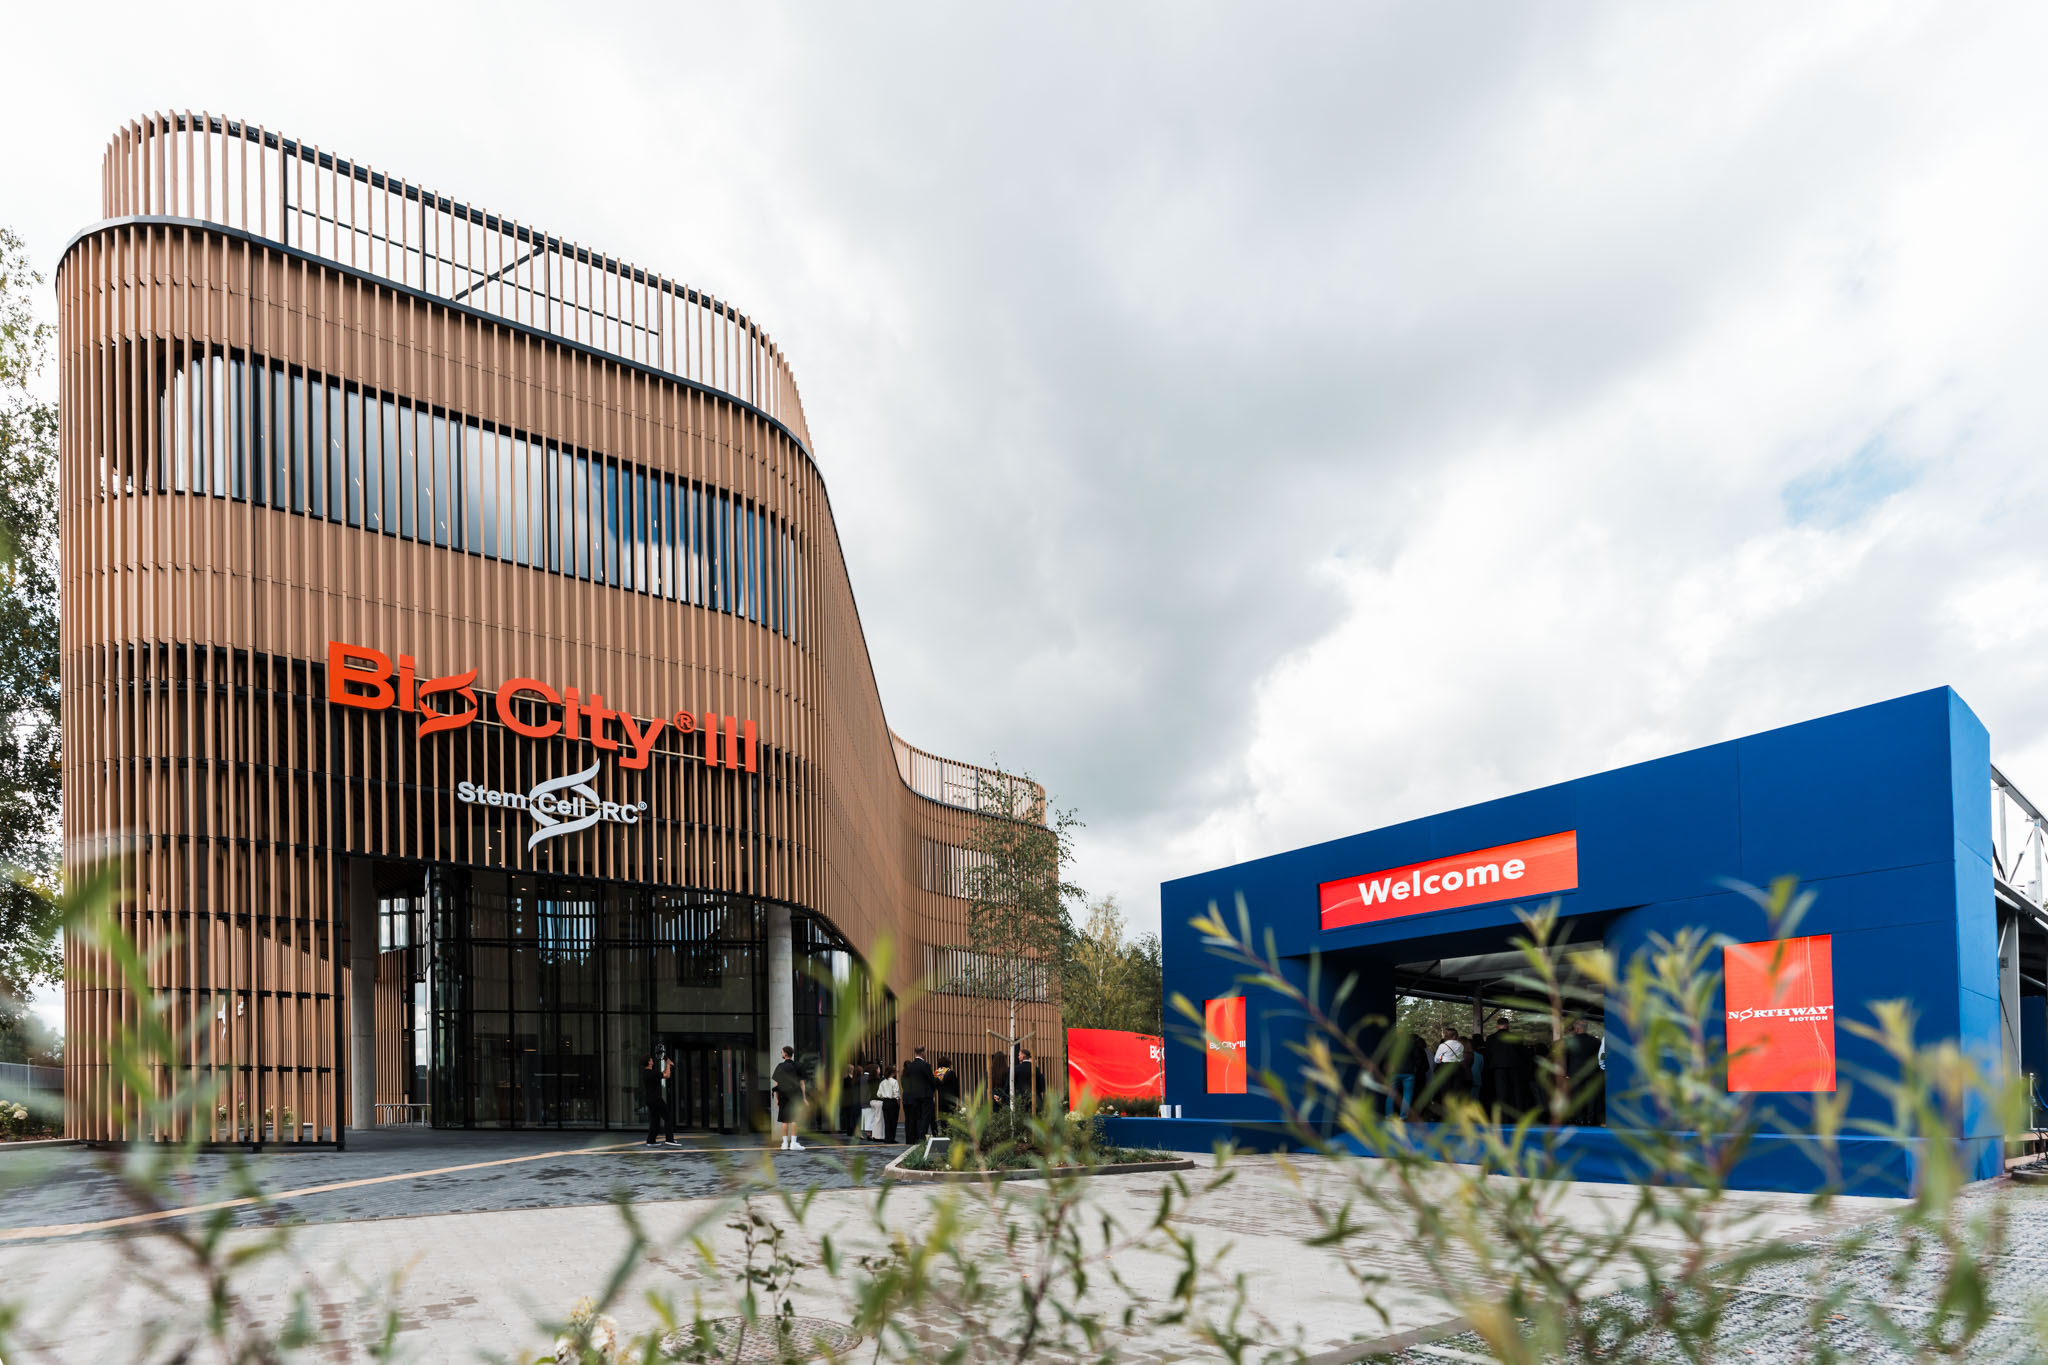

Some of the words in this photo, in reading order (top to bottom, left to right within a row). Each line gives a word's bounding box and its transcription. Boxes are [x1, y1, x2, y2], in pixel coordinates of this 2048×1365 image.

[704, 712, 757, 773] III
[457, 781, 527, 809] Stem
[538, 792, 586, 817] Cell
[1358, 858, 1526, 906] Welcome
